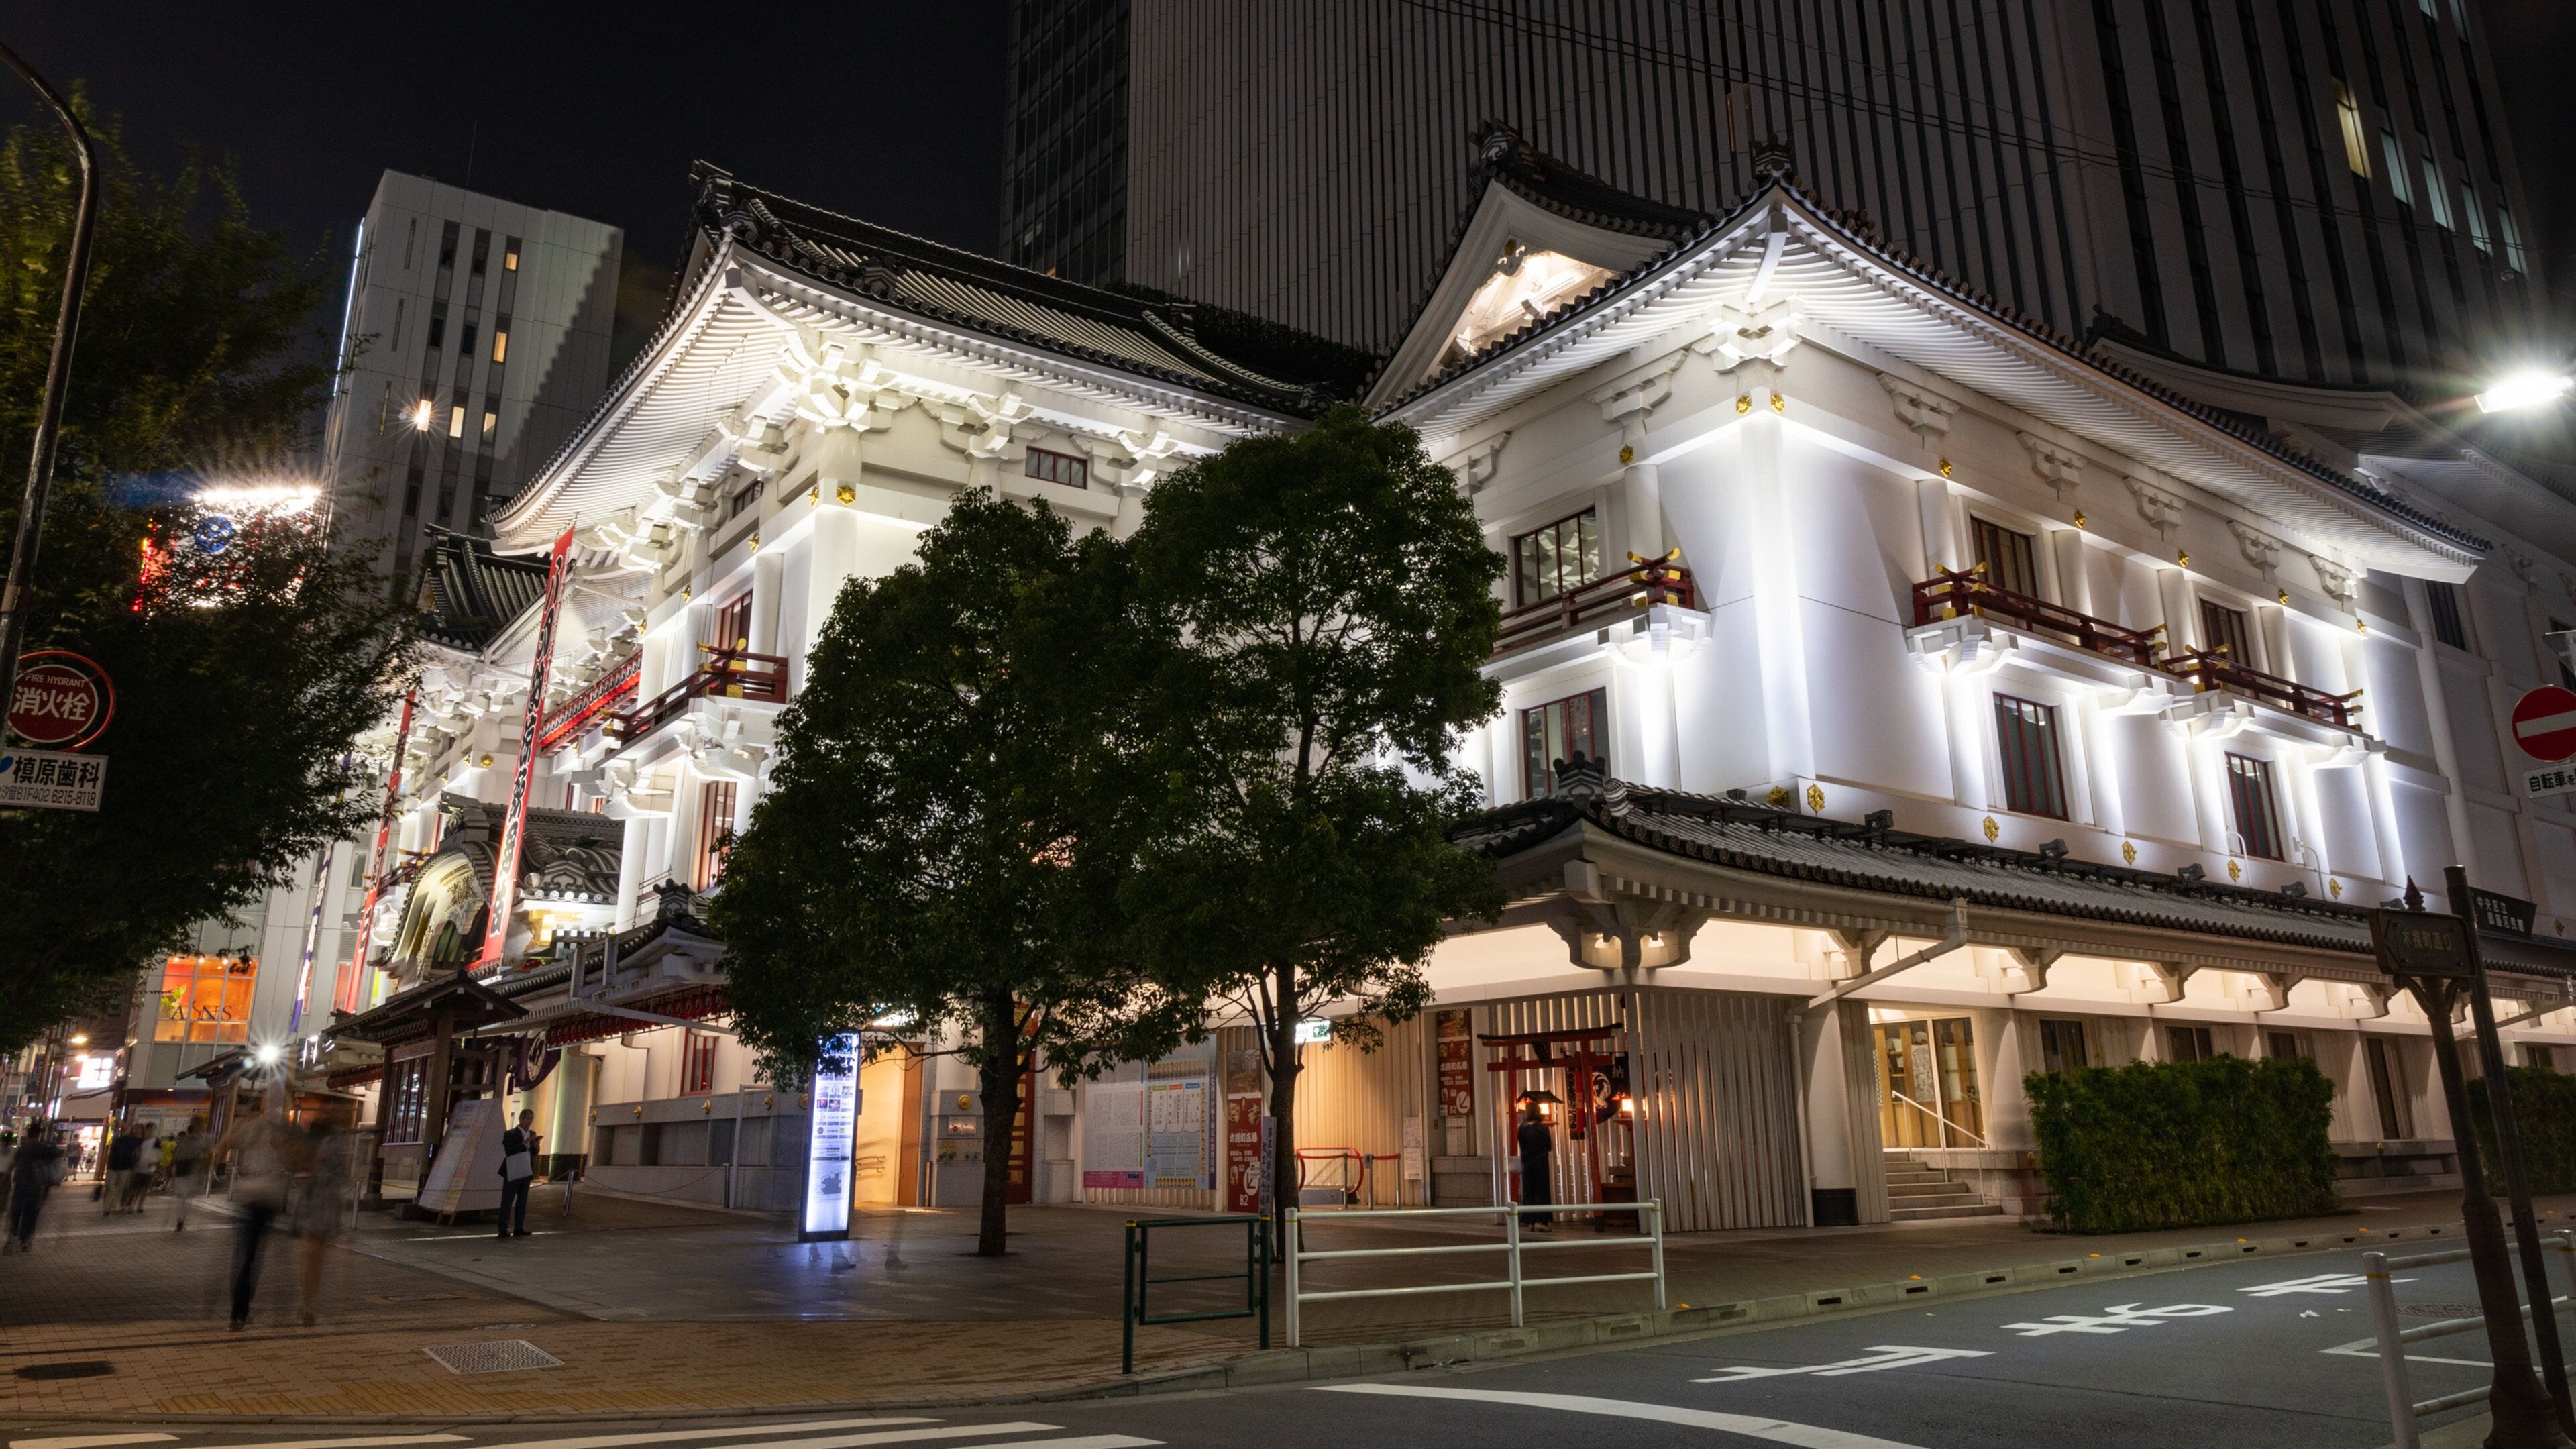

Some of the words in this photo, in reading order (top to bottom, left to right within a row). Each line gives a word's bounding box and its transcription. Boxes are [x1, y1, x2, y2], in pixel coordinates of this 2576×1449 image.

[25, 673, 44, 683] FIRE
[47, 676, 87, 688] HYDRANT
[11, 686, 91, 721] 消火栓
[2528, 768, 2576, 792] 自転車を
[0, 785, 50, 803] 汐留B1F402
[51, 789, 97, 806] 6215-8118
[2476, 896, 2508, 915] 中央区立
[2401, 928, 2453, 951] 木挽町通り
[1449, 1105, 1457, 1114] B2
[1239, 1195, 1249, 1207] B2
